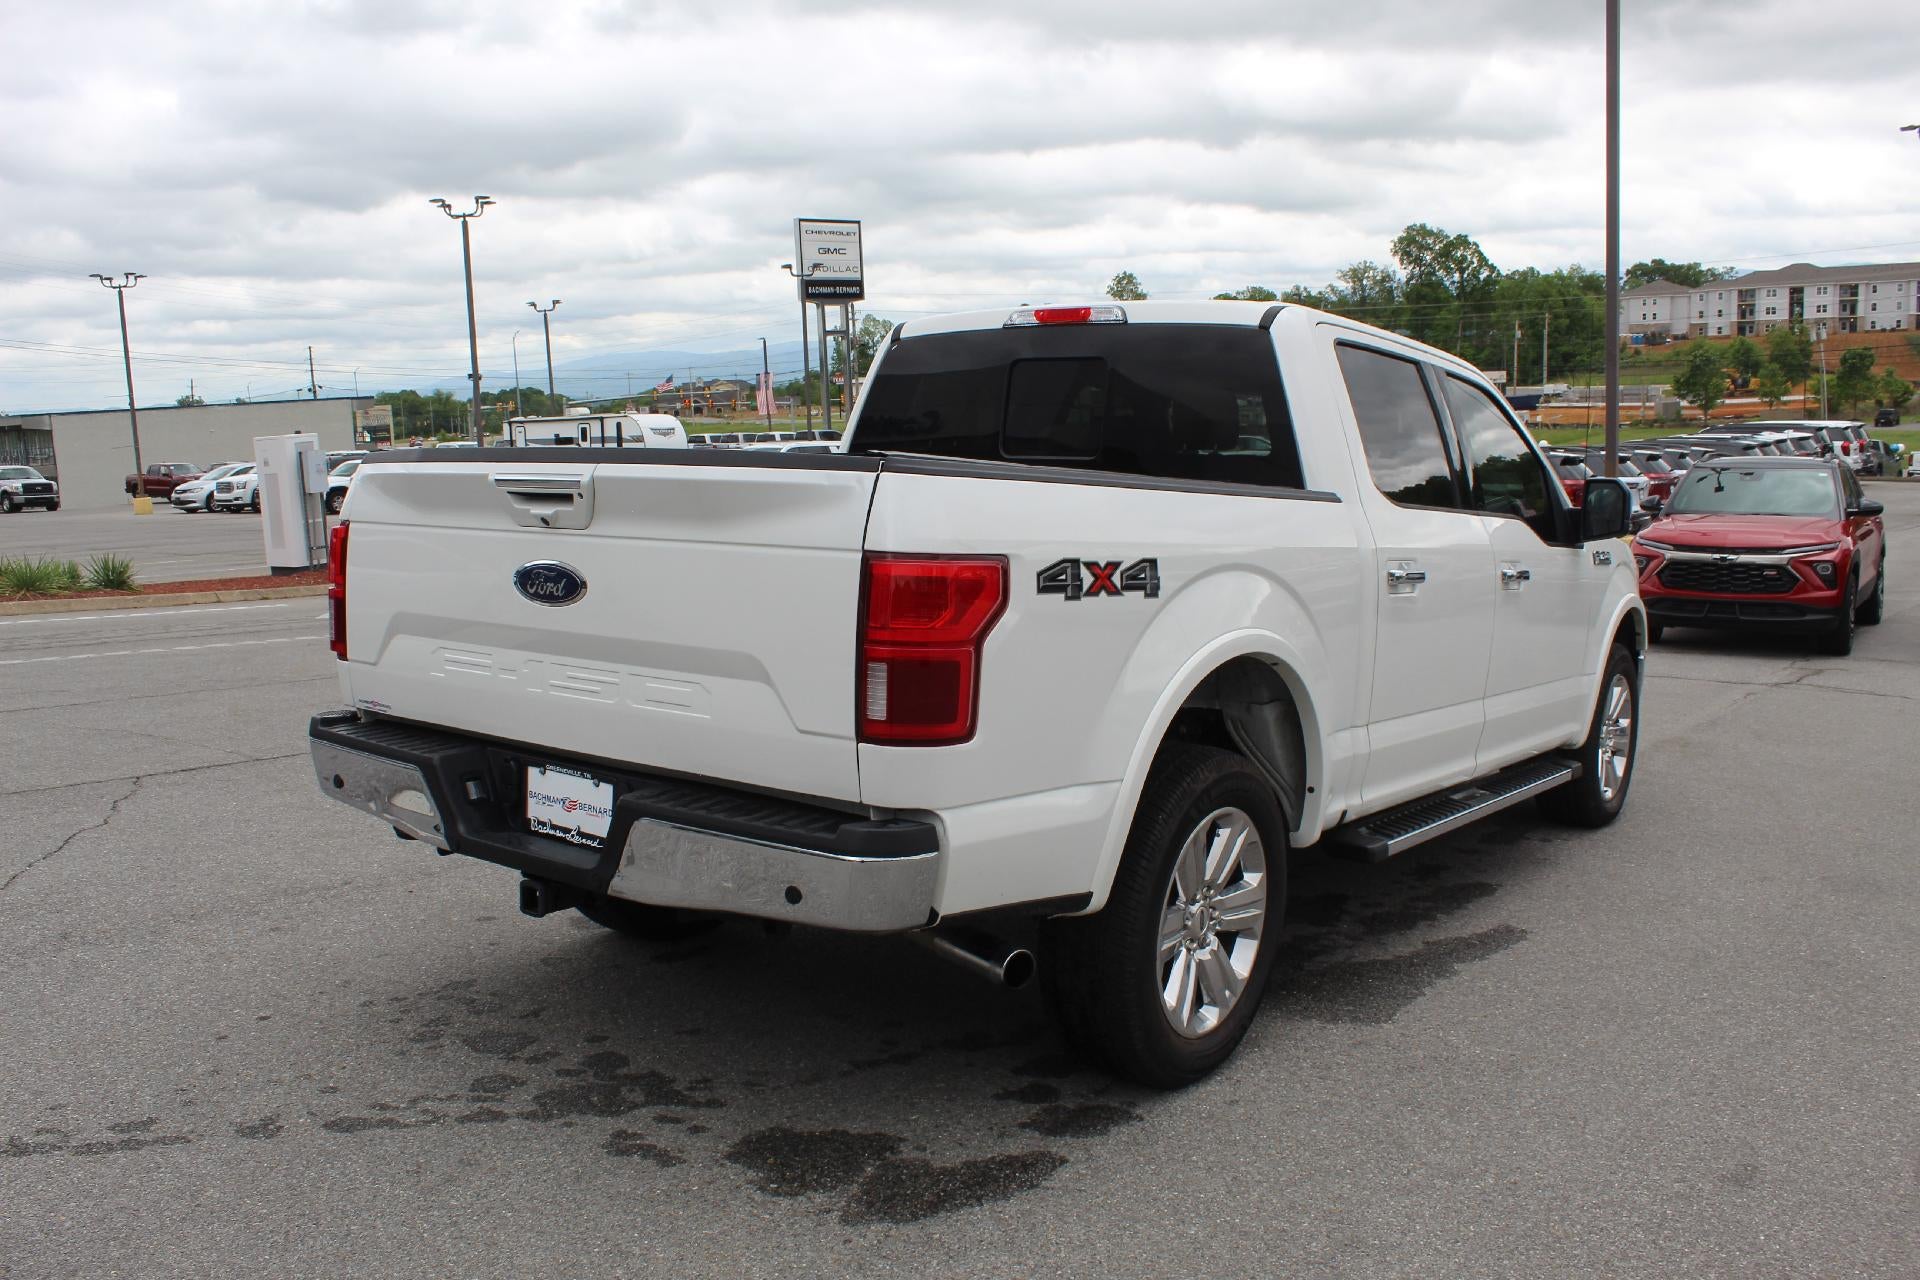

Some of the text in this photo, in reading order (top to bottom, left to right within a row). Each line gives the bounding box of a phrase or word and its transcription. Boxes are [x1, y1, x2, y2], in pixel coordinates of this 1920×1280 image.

[818, 247, 847, 255] GMC
[807, 265, 859, 273] CADILLAC
[527, 569, 567, 597] Ford
[528, 790, 561, 804] BACHMAN
[578, 802, 613, 817] BERNARD
